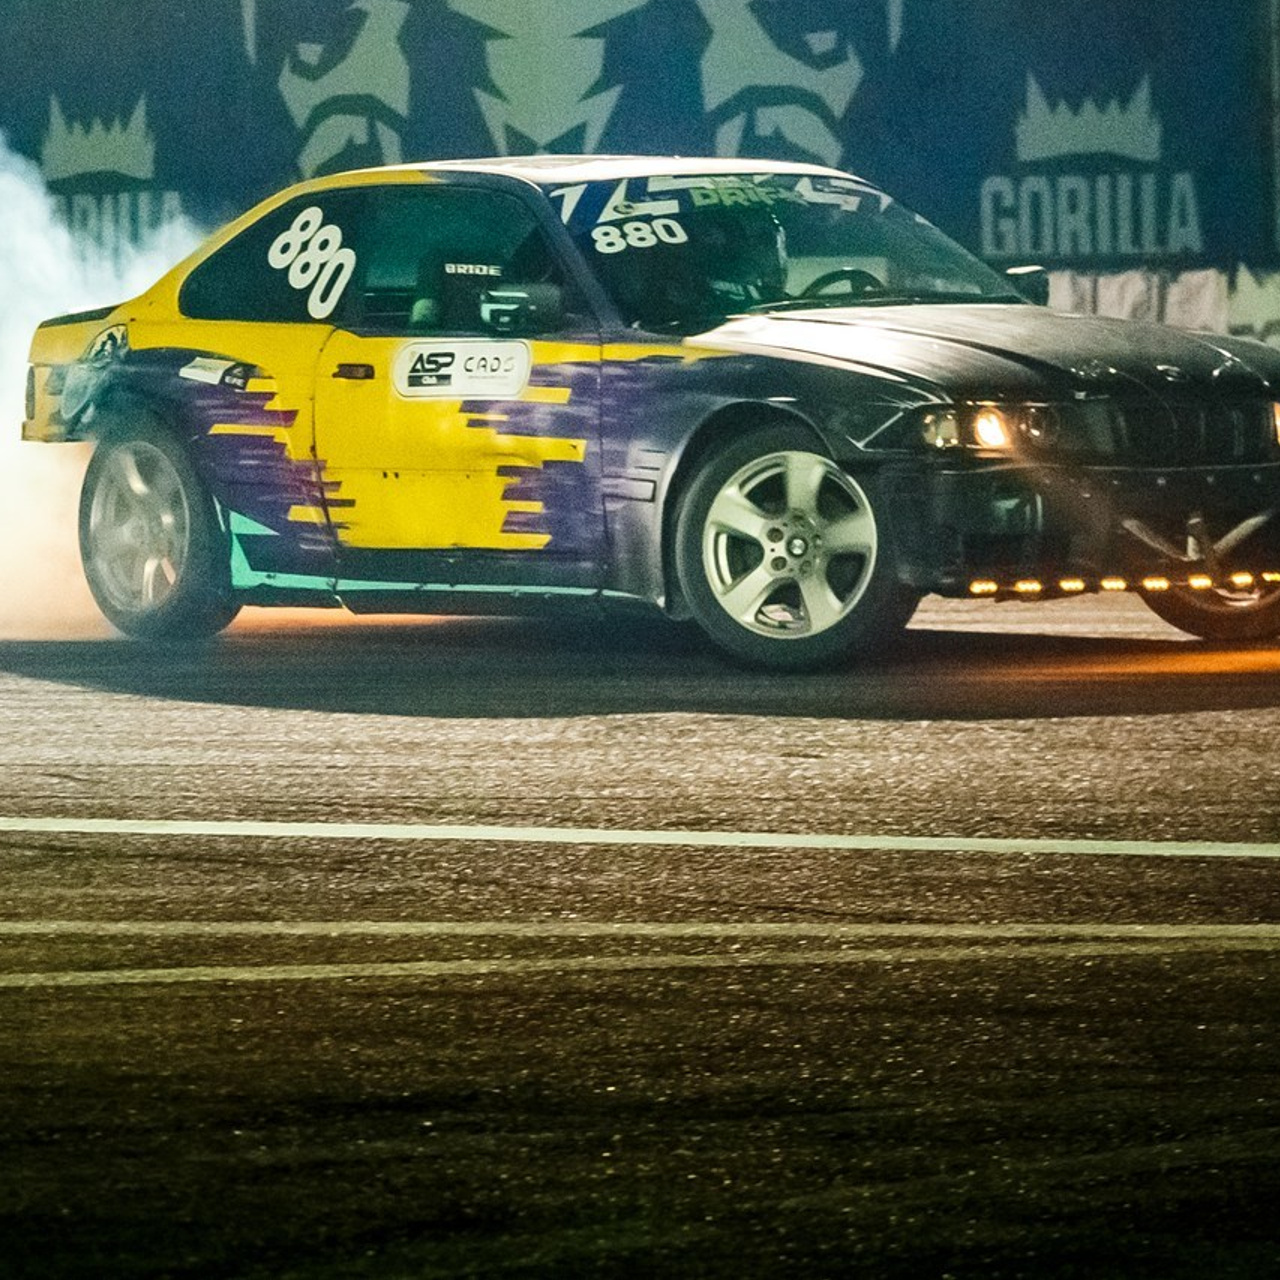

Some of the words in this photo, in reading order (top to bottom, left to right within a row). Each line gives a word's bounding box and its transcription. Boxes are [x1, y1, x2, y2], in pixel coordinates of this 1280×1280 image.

[979, 173, 1204, 255] GORILLA
[591, 218, 689, 254] 880
[268, 206, 357, 320] 880
[444, 263, 502, 277] BRIDE
[409, 352, 456, 374] ASP
